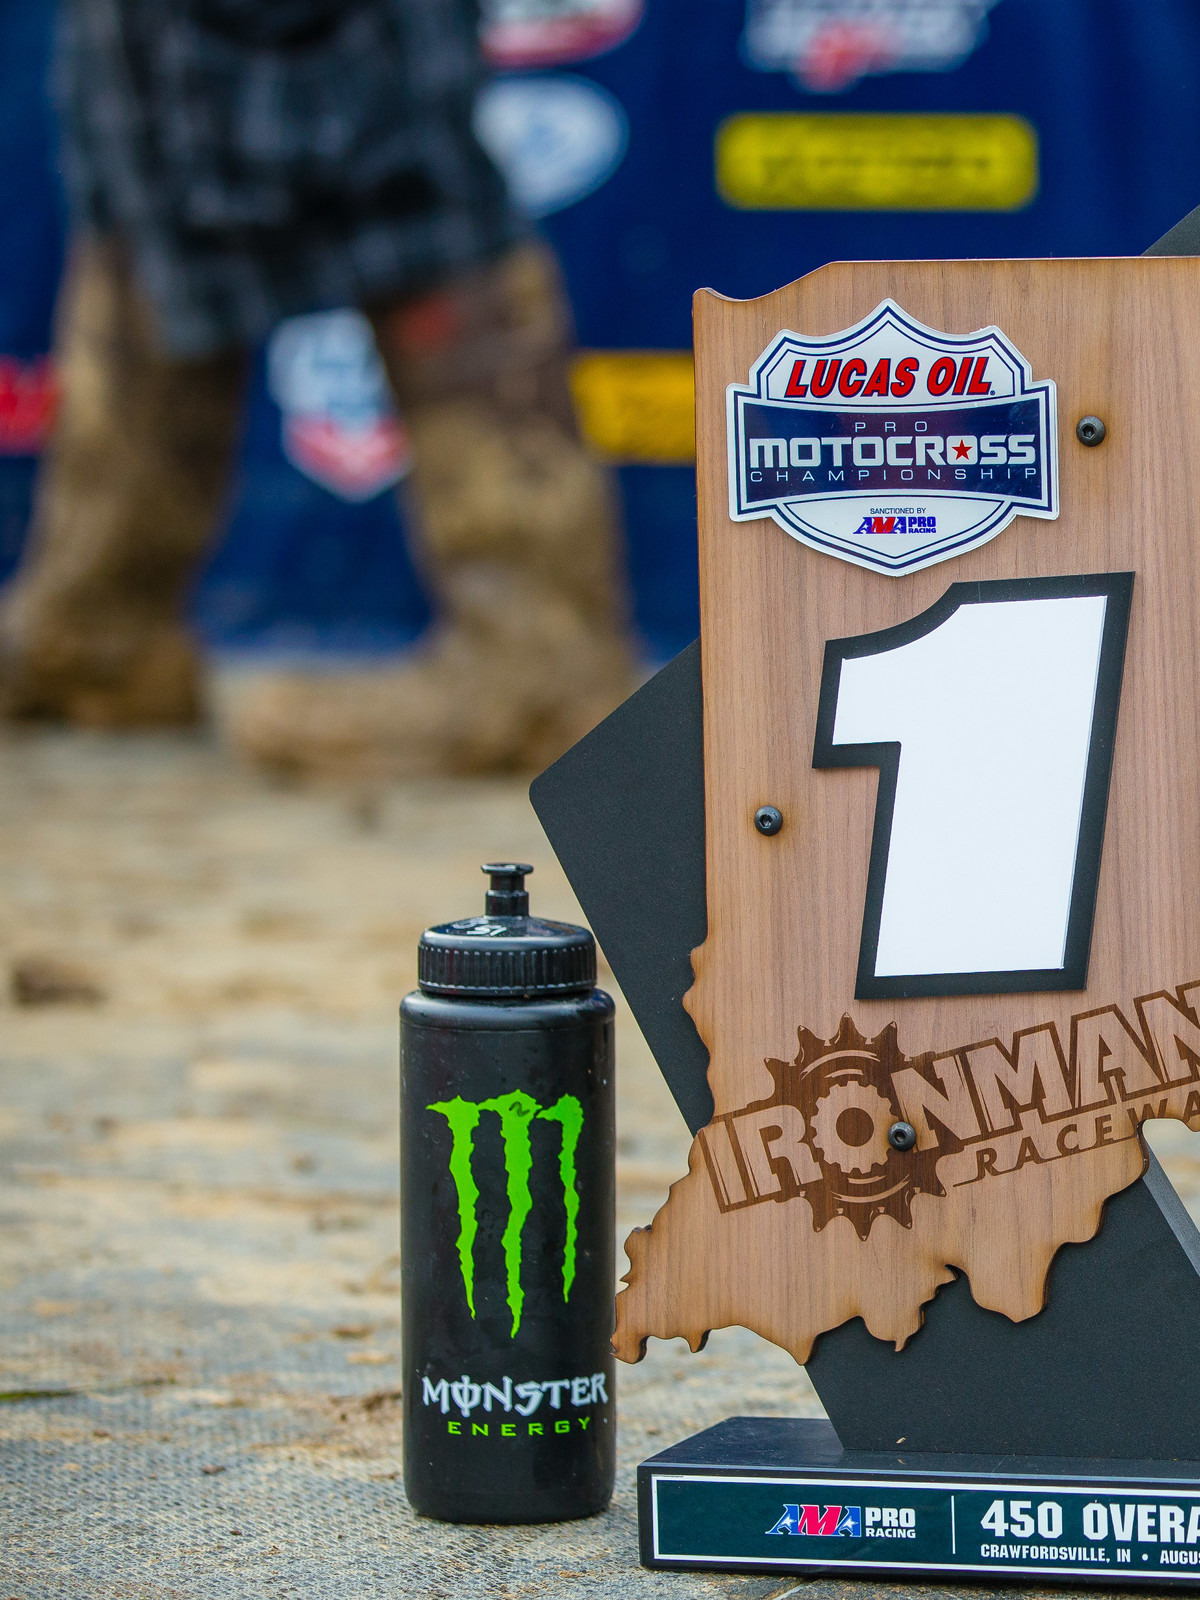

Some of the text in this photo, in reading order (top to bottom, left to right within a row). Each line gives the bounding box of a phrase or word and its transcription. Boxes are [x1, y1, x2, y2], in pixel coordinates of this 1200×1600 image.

[784, 356, 992, 398] LUCAS OIL
[854, 421, 928, 433] PRO
[749, 434, 1036, 468] MOTOCROSS
[749, 468, 1036, 482] CHAMPIONSHIP
[869, 507, 915, 515] SANCTIONED
[853, 516, 936, 534] AMA PRO
[812, 571, 1135, 1000] 1
[422, 1372, 609, 1418] MONSTER
[447, 1416, 591, 1437] ENERGY
[765, 1504, 916, 1537] AMA PRO
[980, 1499, 1063, 1539] 450
[865, 1527, 916, 1538] RACING
[980, 1543, 1110, 1563] CRAWFORDSVILLE,
[1116, 1548, 1131, 1562] IN
